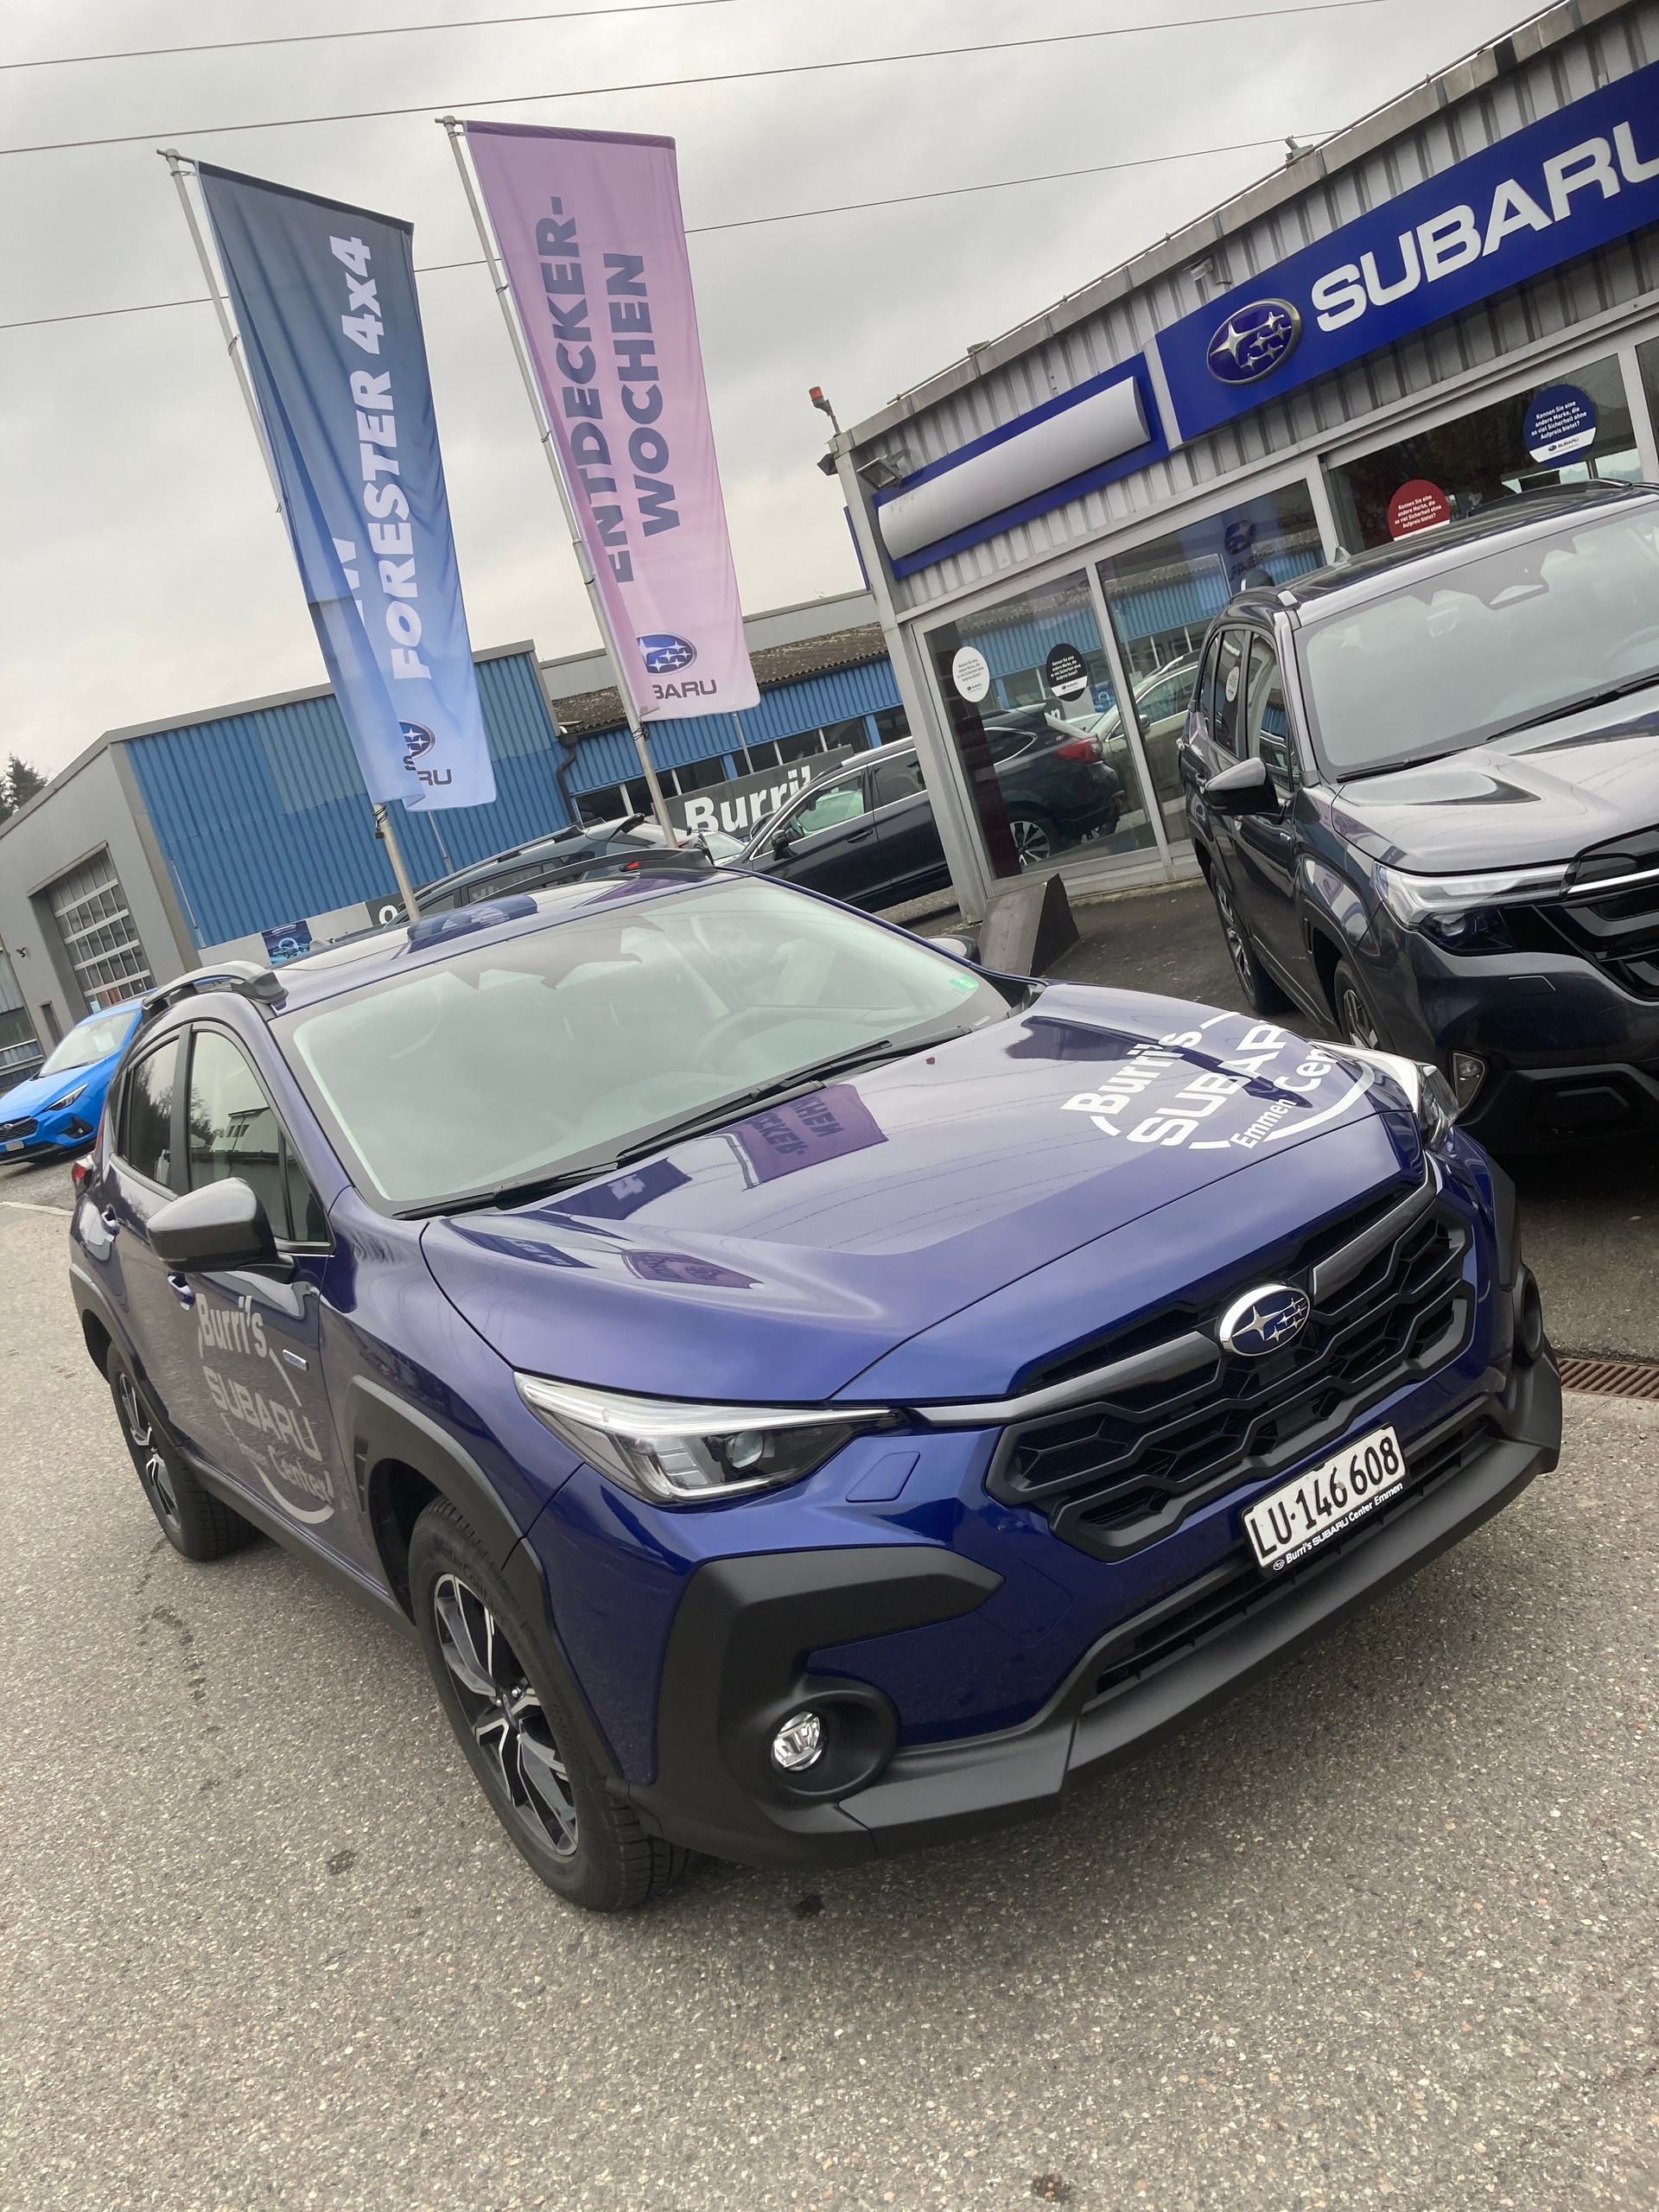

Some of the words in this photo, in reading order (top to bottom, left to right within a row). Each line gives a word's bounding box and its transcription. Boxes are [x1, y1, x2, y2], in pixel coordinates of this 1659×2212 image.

[330, 235, 385, 355] 4x4
[536, 196, 634, 584] ENTDECKER-
[603, 253, 680, 537] WOCHEN
[1535, 409, 1556, 421] Kennen
[1535, 416, 1553, 428] andere
[1553, 410, 1572, 422] Marke,
[1538, 425, 1548, 434] viel
[1548, 416, 1573, 430] Sicherheit
[1573, 411, 1587, 421] ohne
[1541, 427, 1562, 440] Aufpreis
[1561, 420, 1580, 432] bietet?
[350, 371, 432, 680] FORESTER
[652, 679, 717, 700] BARU
[683, 766, 811, 832] Burri'
[1059, 1031, 1203, 1115] Burri's
[1126, 1022, 1288, 1147] SUBAR
[1229, 1098, 1298, 1149] Emmen
[1273, 1048, 1338, 1092] Cen
[195, 1293, 268, 1357] Burri's
[202, 1365, 323, 1462] SUBARU
[1285, 1541, 1313, 1564] Burri's
[1312, 1516, 1349, 1547] SUBARU
[1348, 1501, 1373, 1522] Center
[1374, 1482, 1403, 1505] Emmen
